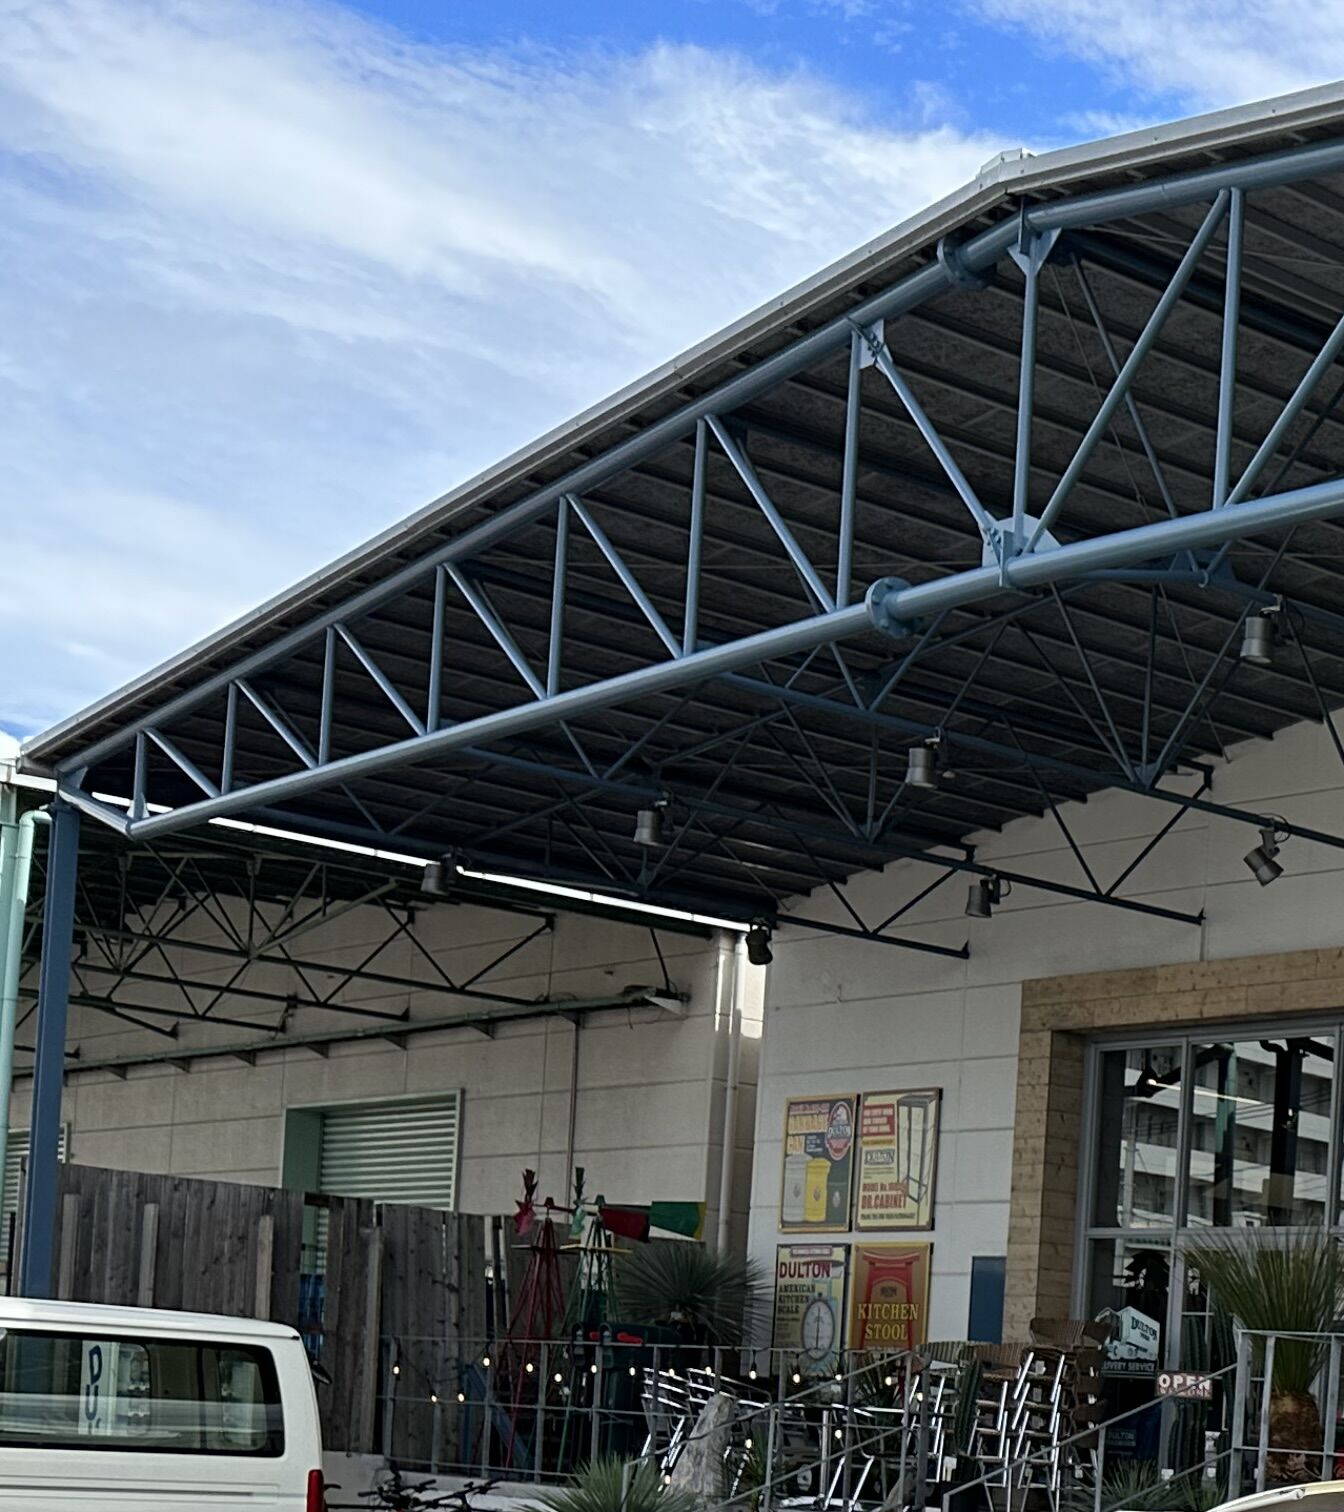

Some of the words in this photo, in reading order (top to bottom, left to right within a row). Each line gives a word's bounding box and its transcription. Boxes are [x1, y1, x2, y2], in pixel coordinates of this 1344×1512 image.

[779, 1261, 831, 1279] DULTON
[857, 1303, 919, 1320] KITCHEN
[864, 1323, 908, 1340] STOOL
[1158, 1374, 1211, 1390] OPEN
